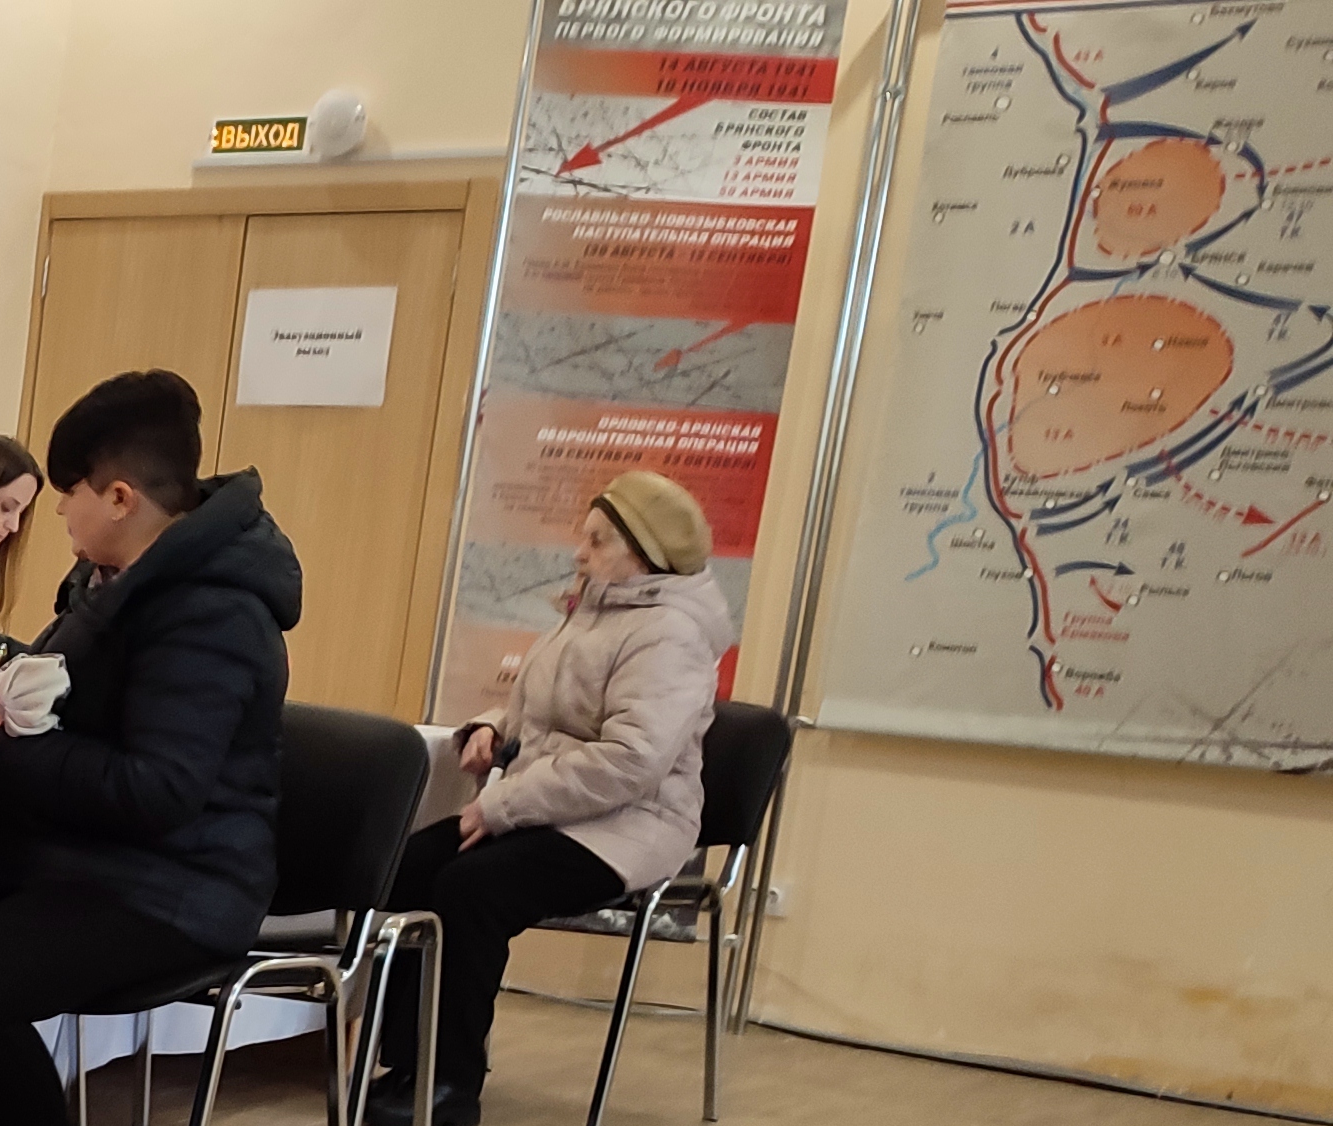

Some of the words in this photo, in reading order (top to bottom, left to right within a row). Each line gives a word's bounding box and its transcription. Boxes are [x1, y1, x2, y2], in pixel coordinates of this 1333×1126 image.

[719, 0, 827, 26] ФРОНТА
[554, 21, 645, 41] ПЕРВОГО
[653, 25, 825, 48] ФОРМИРОВАНИЯ
[683, 58, 768, 76] АВГУСТА
[748, 108, 808, 121] СОСТАВ
[221, 122, 300, 149] ВЫХОД
[713, 121, 806, 138] БРЯНСКОГО
[741, 139, 803, 152] ФРОНТА
[744, 155, 800, 169] АРМИЯ
[741, 170, 798, 184] АРМИЯ
[738, 186, 795, 199] АРМИЯ
[709, 230, 796, 250] ОПЕРАЦИЯ
[677, 436, 761, 455] ОПЕРАЦИЯ
